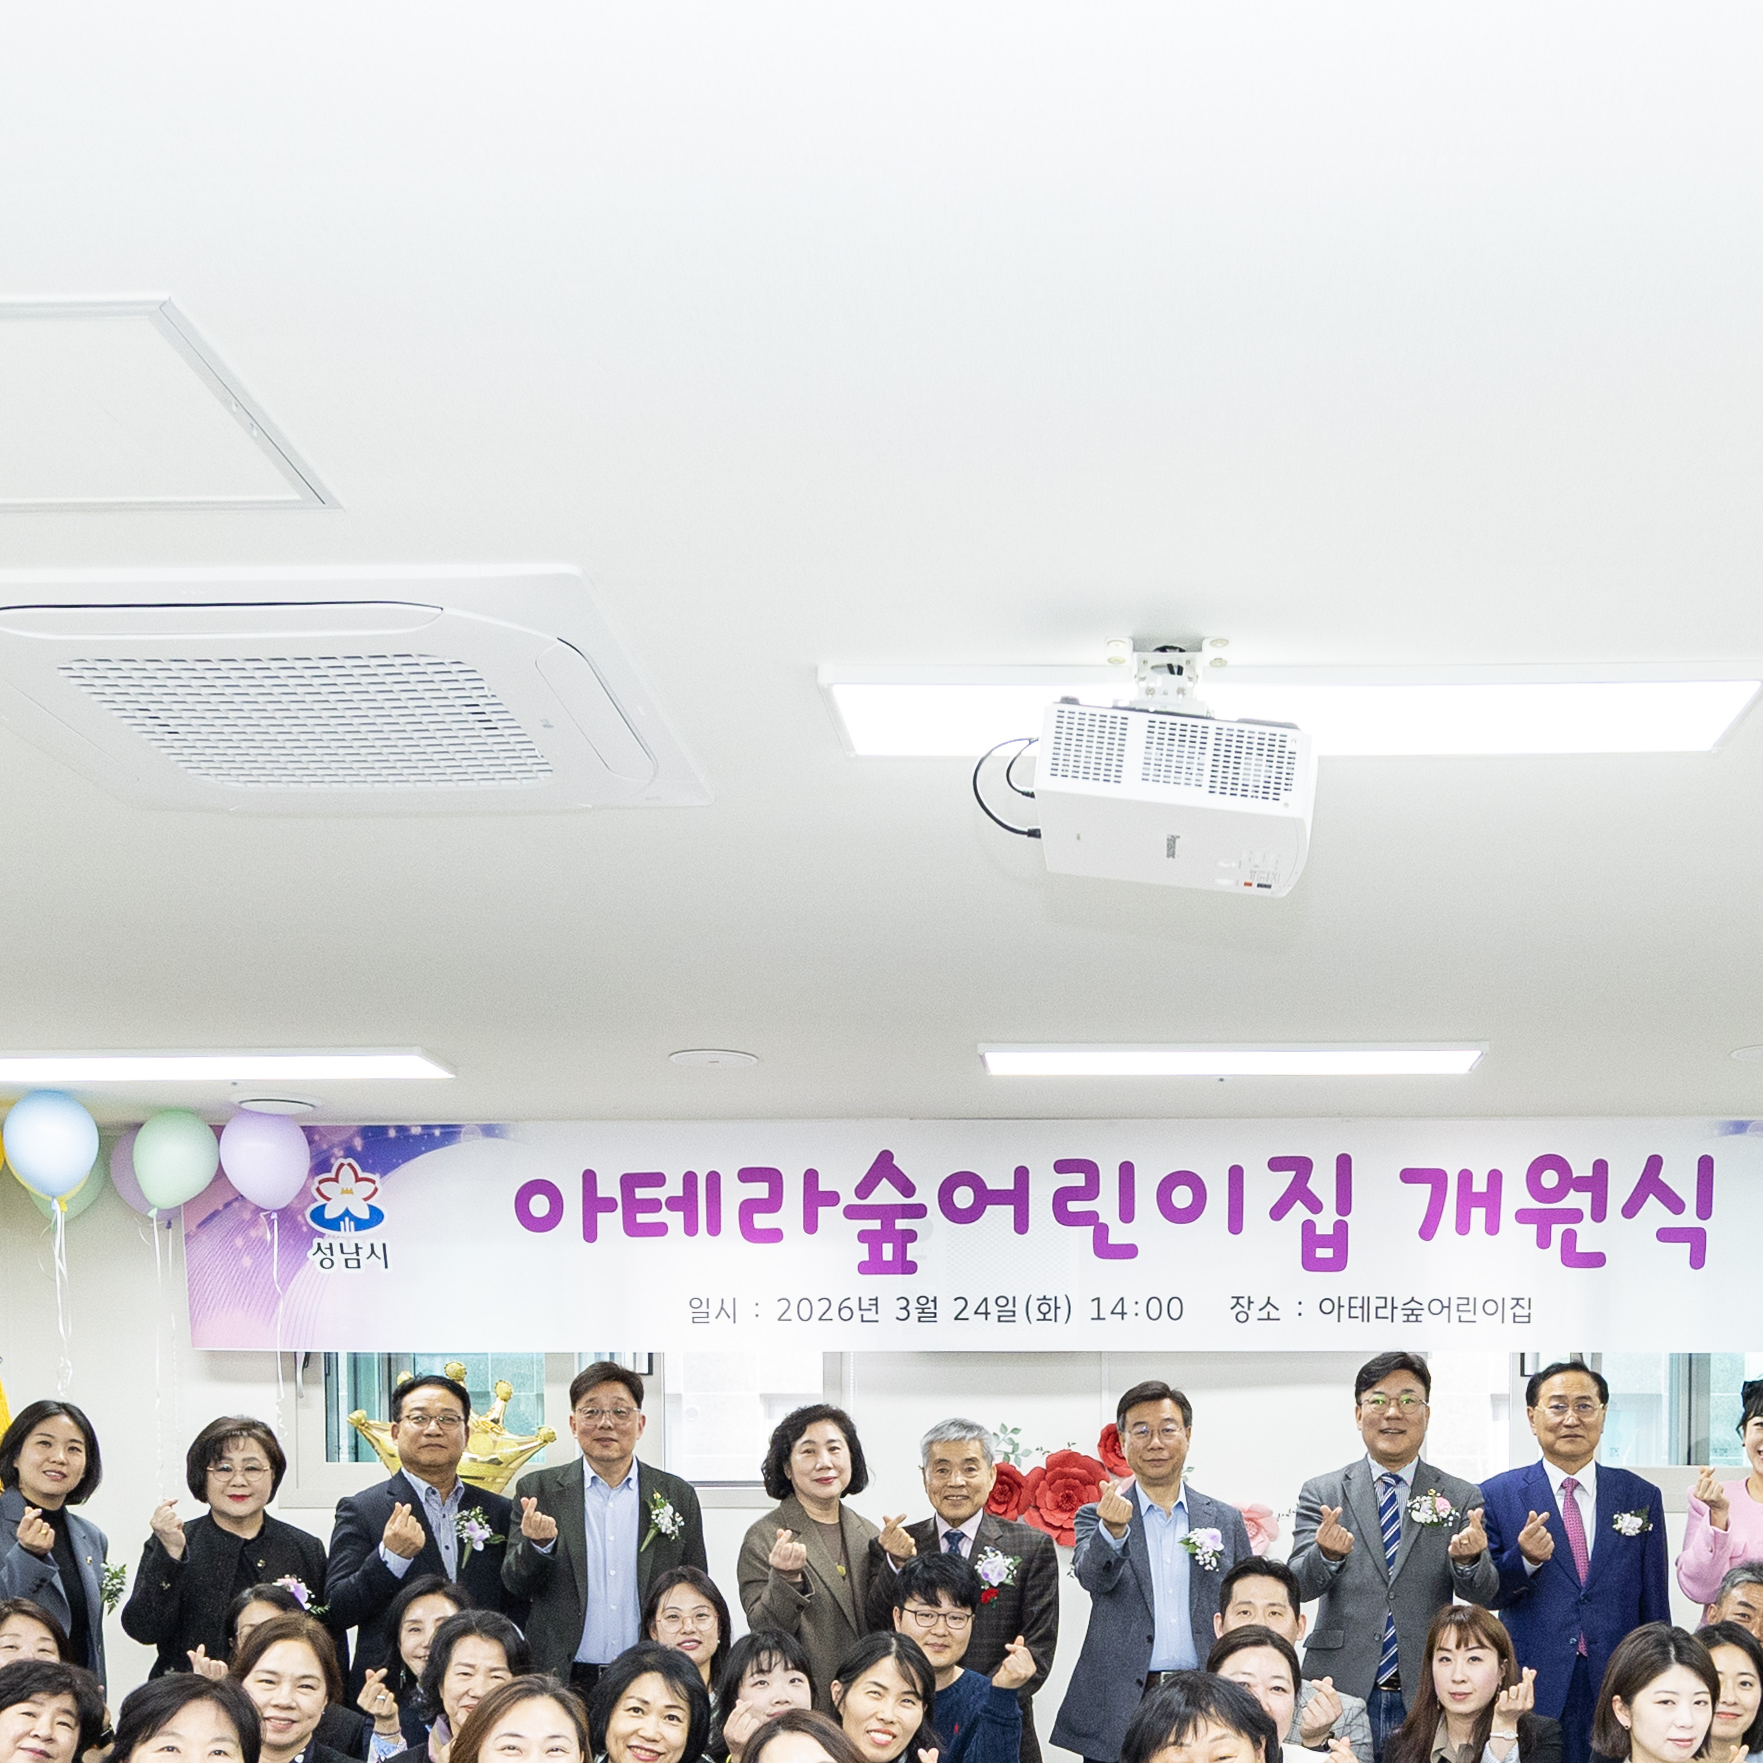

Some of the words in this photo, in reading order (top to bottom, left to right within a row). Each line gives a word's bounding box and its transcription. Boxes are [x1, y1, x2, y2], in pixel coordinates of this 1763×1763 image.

[513, 1148, 1354, 1276] 아테라숲어린이집
[1399, 1152, 1716, 1271] 개원식
[310, 1240, 390, 1271] 성남시
[688, 1295, 738, 1325] 일시
[776, 1295, 881, 1325] 2026년
[894, 1294, 940, 1325] 3월
[952, 1294, 1073, 1326] 24일(화)
[1089, 1296, 1185, 1323] 14:00
[1229, 1294, 1283, 1325] 장소
[1318, 1294, 1534, 1326] 아테라숲어린이집
